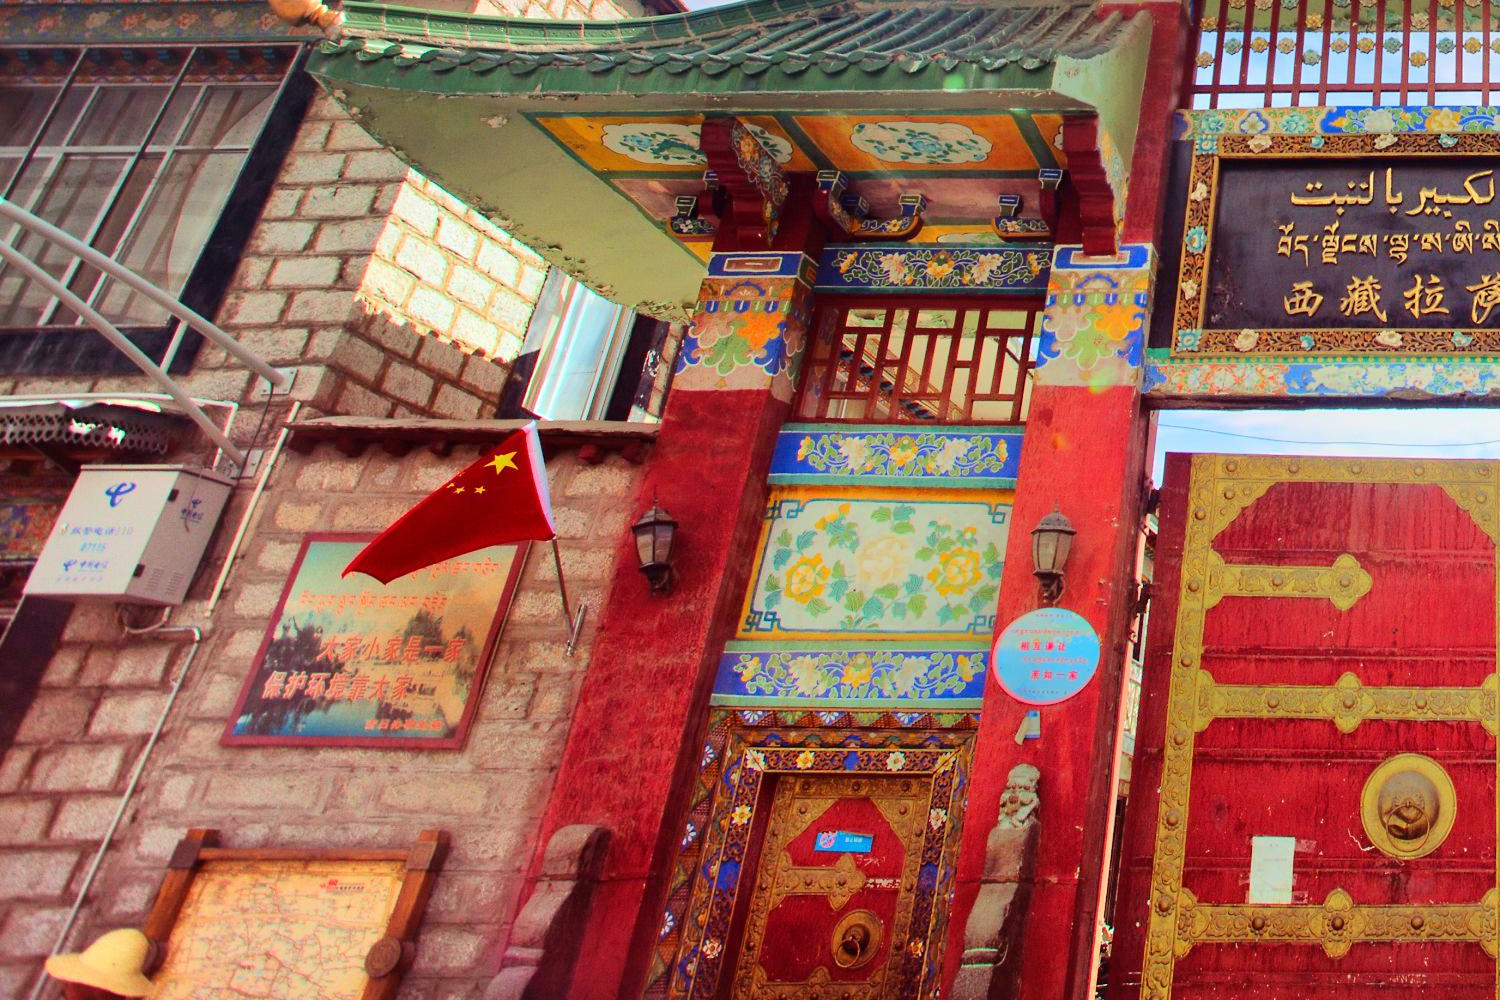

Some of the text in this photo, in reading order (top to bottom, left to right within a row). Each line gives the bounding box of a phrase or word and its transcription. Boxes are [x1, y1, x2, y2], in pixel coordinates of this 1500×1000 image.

[316, 635, 466, 662] 大家小家是一家
[262, 670, 413, 700] 保护环境靠大家
